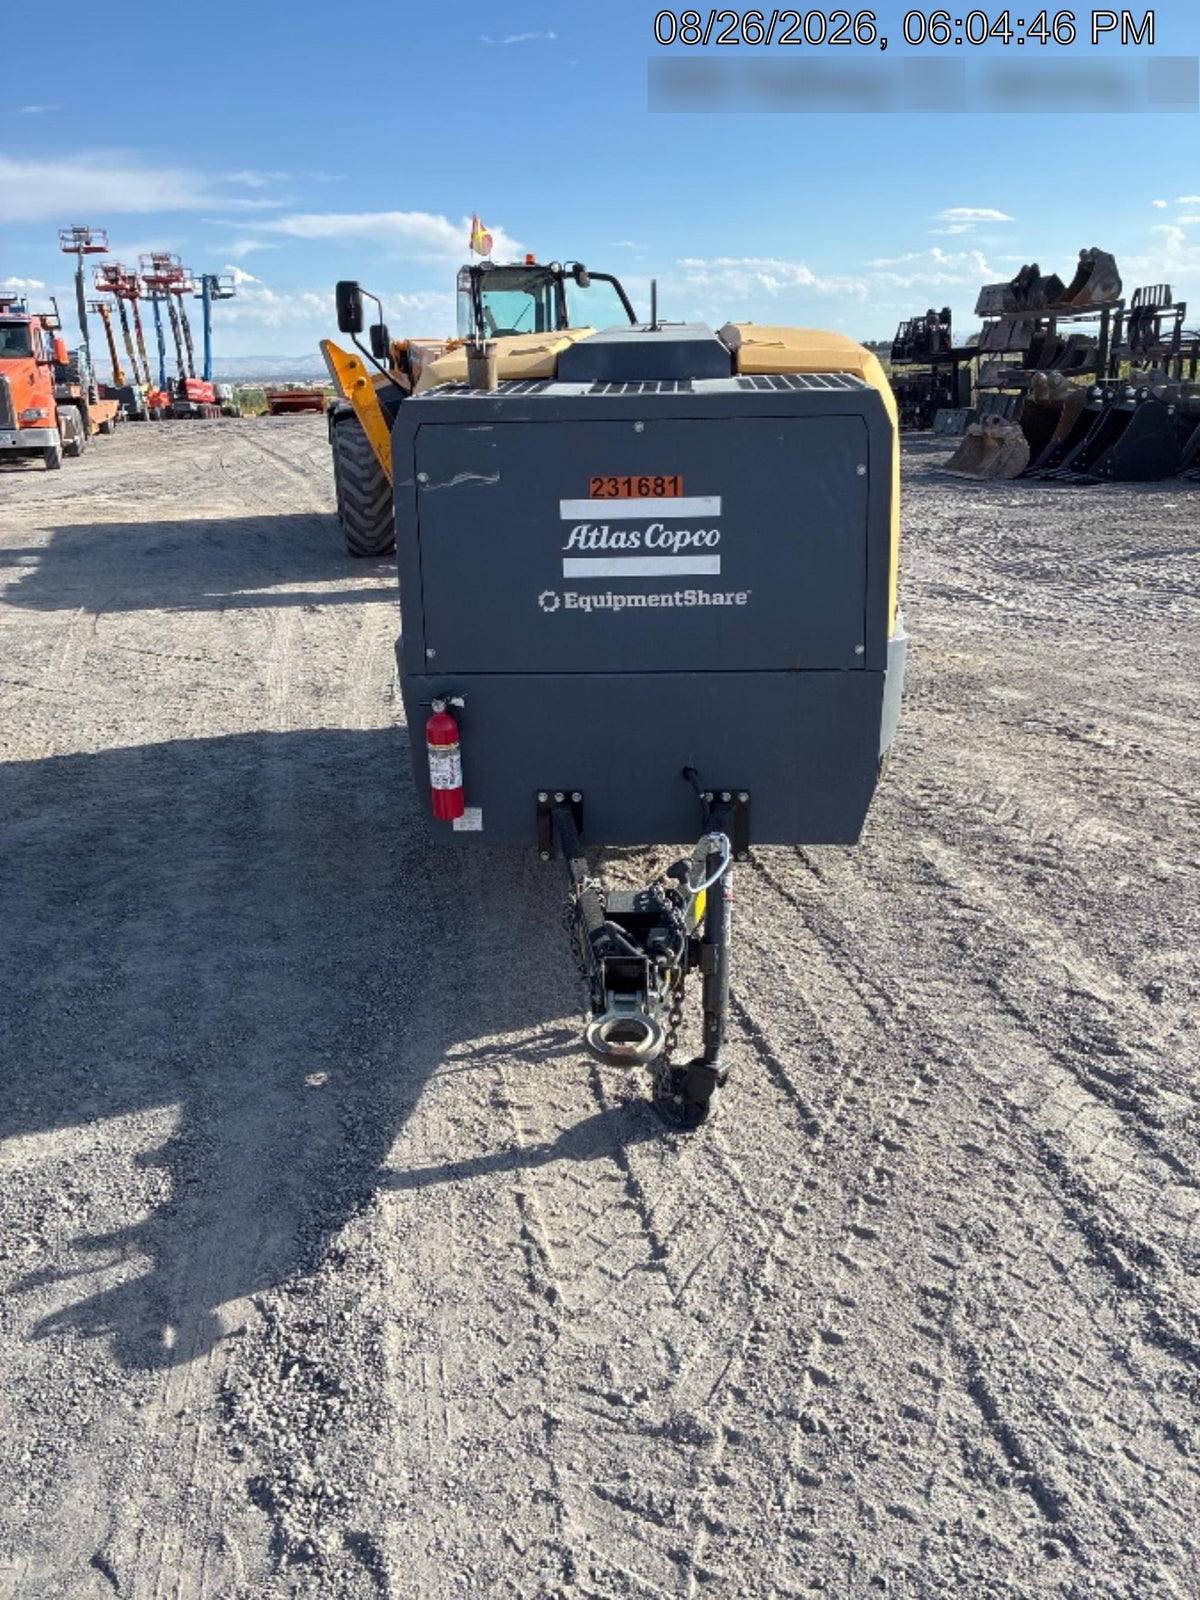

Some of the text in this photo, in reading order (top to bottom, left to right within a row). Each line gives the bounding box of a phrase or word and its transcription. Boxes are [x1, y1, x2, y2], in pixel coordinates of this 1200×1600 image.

[591, 476, 680, 497] 231681
[562, 522, 721, 553] Atlas Copco
[563, 589, 748, 612] EquipmentShare
